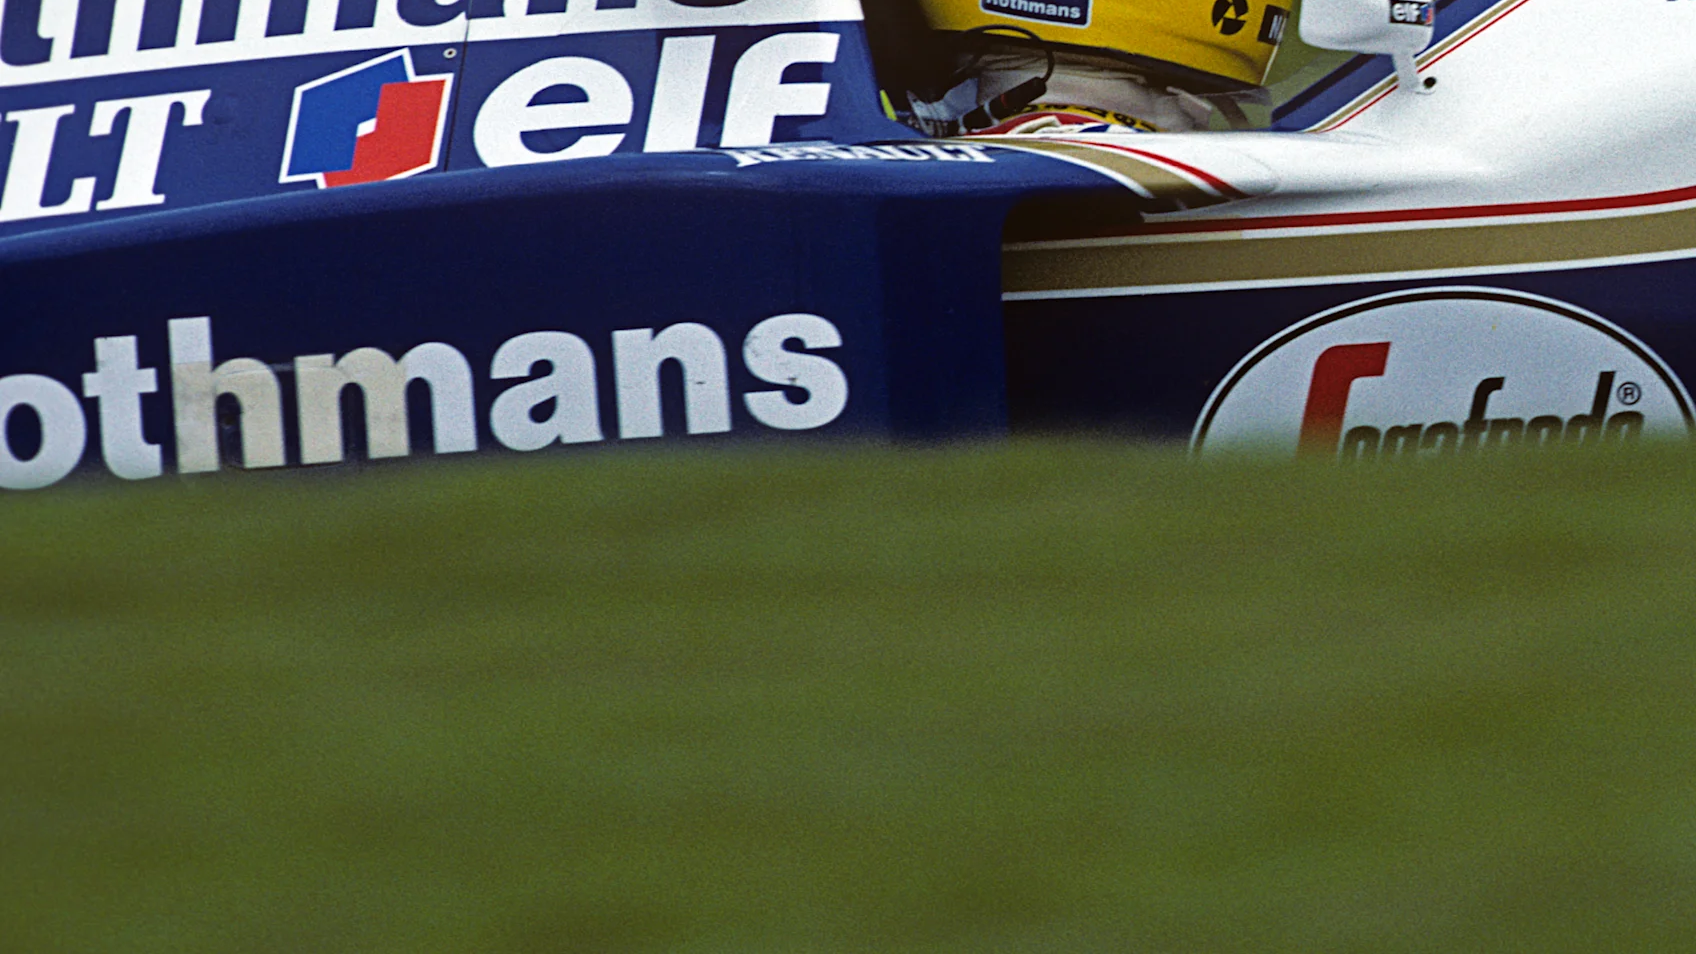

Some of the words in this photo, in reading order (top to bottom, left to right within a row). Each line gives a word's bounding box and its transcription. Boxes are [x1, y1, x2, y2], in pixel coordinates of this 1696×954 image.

[1393, 2, 1421, 22] elf
[473, 32, 841, 168] elf
[724, 145, 996, 168] RENAULT
[0, 312, 849, 490] othmans
